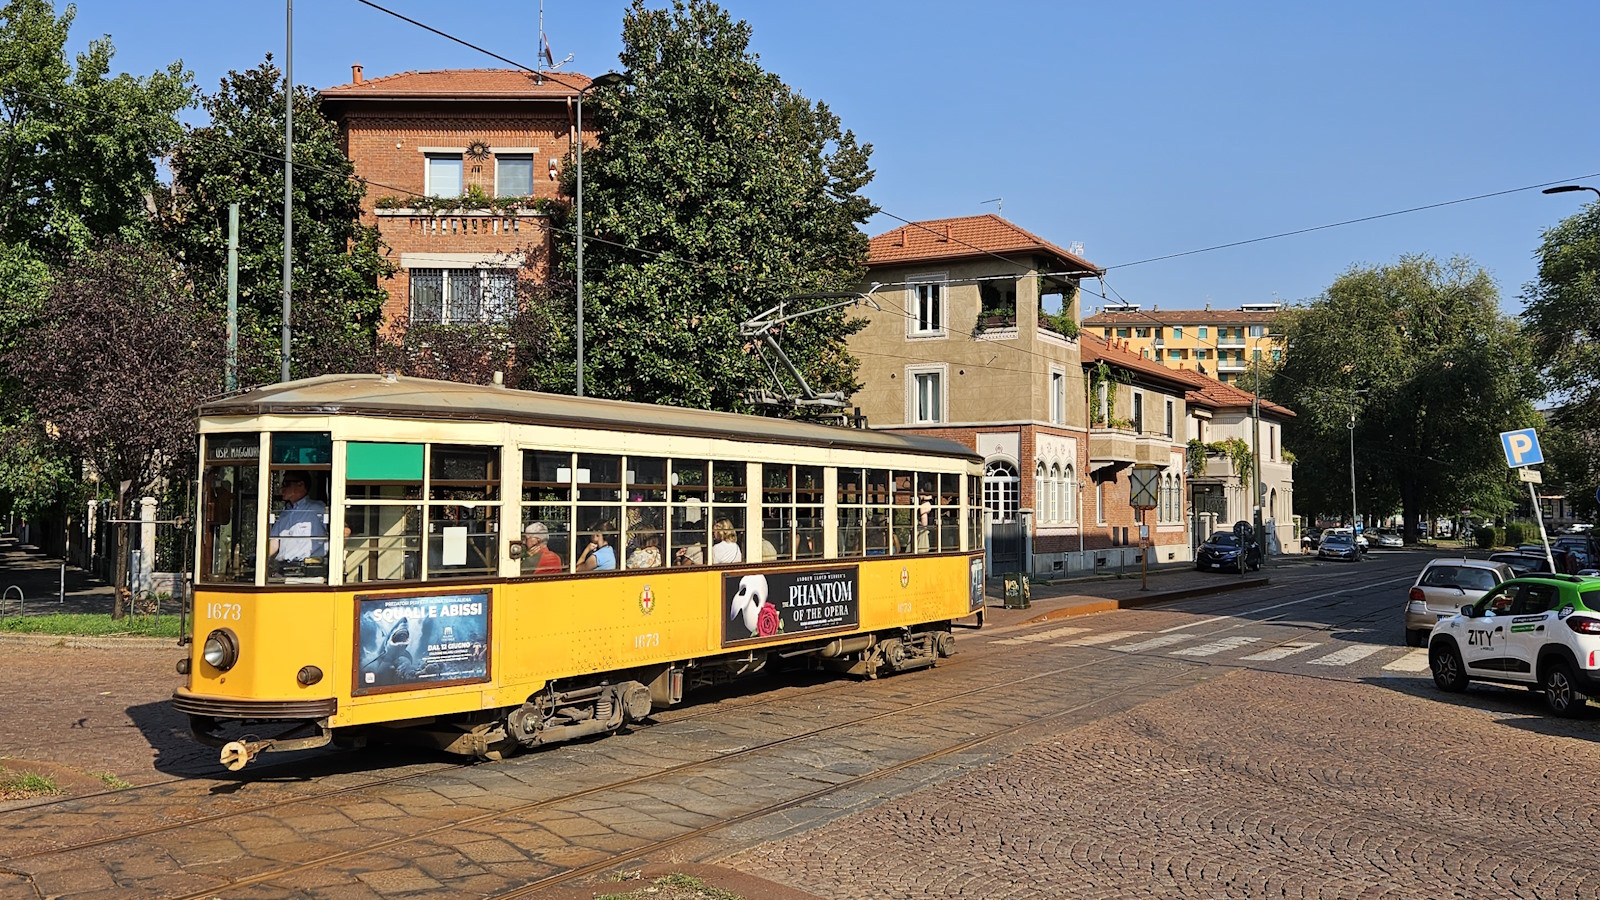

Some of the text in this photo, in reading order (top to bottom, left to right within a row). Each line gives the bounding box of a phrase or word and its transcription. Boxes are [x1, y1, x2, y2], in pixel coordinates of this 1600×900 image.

[1508, 434, 1532, 463] P
[789, 580, 853, 607] PHANTOM
[207, 602, 242, 621] 1673
[373, 602, 483, 623] SQUALI E ABISSI
[793, 609, 805, 622] OF
[806, 607, 822, 620] THE
[824, 605, 849, 618] OPERA
[427, 644, 441, 652] DAL
[447, 641, 471, 650] GIUGNO
[635, 632, 660, 649] 1673
[1468, 629, 1494, 647] ZITY
